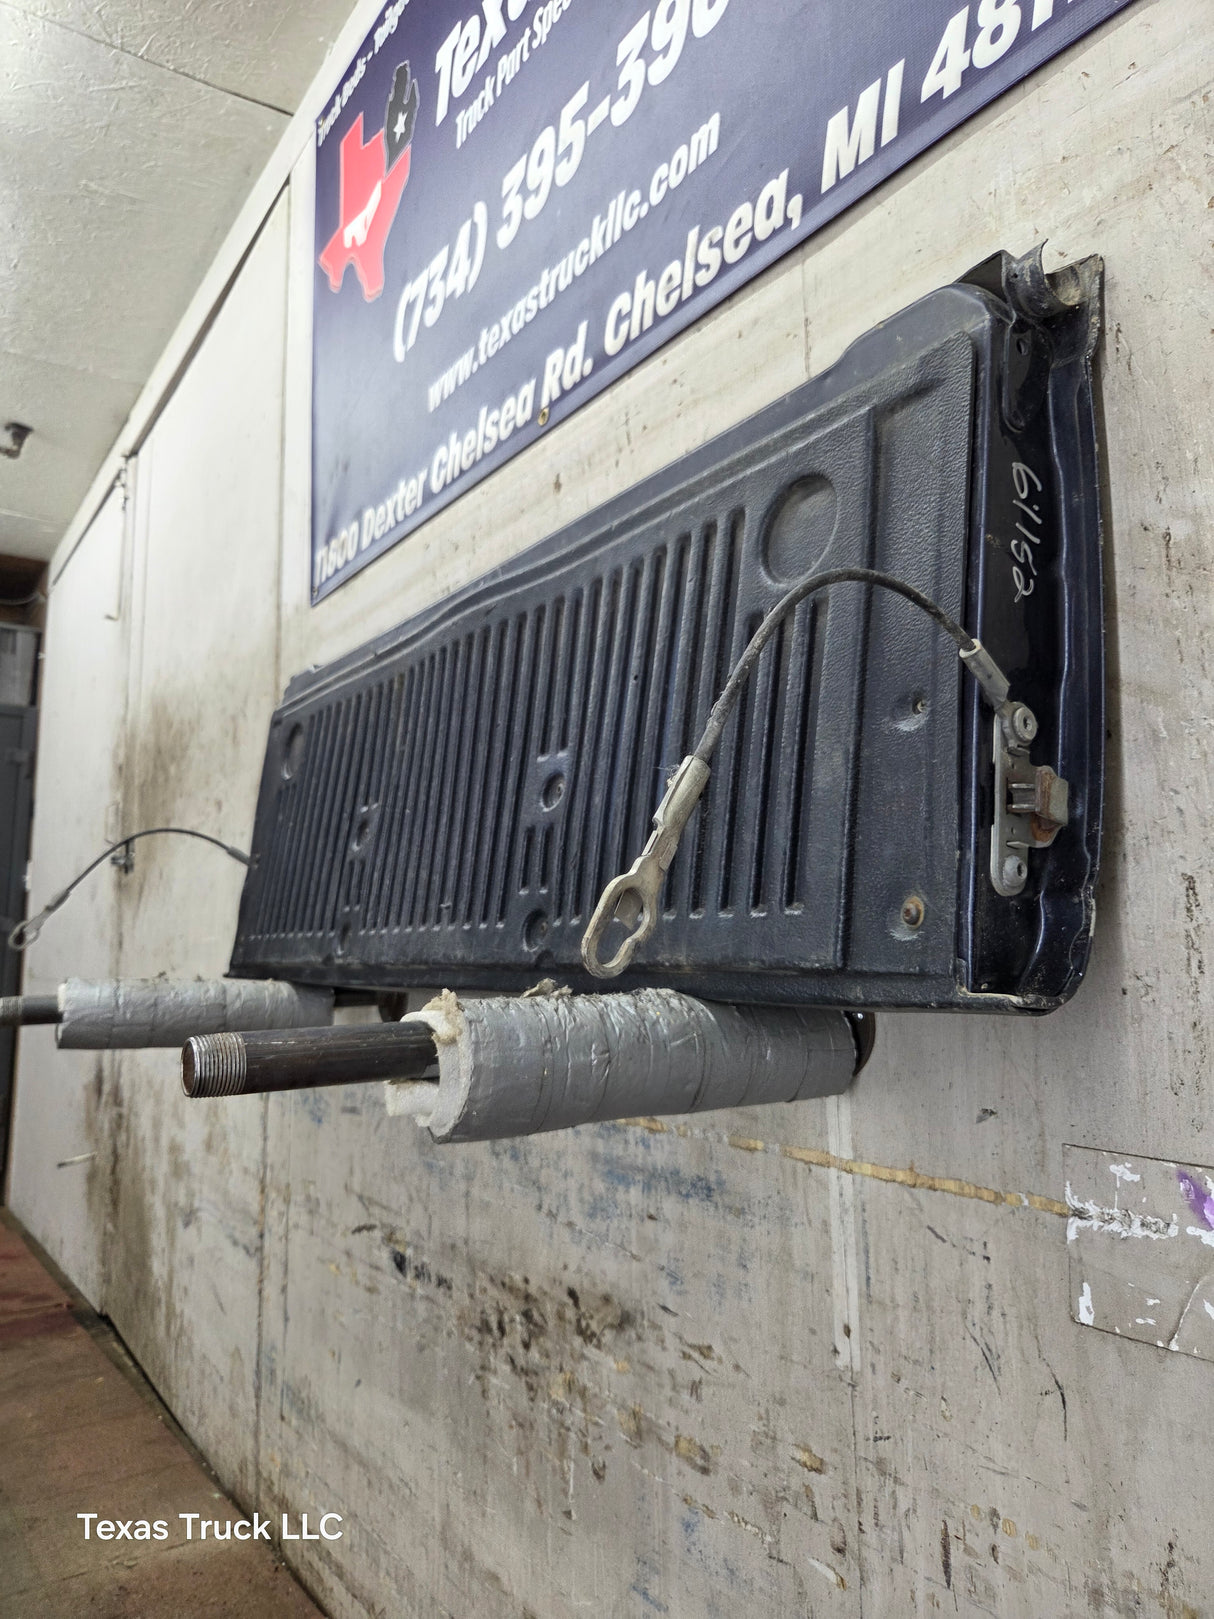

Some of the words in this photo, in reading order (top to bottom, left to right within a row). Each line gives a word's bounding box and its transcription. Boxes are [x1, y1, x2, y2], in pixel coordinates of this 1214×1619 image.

[435, 0, 529, 127] Tex
[456, 109, 495, 149] Truck
[496, 27, 531, 97] Part
[361, 468, 428, 551] Dexter
[430, 378, 537, 494] Chelsea
[540, 319, 594, 409] Rd.
[604, 167, 803, 356] Chelsea,
[821, 58, 905, 194] MI
[393, 201, 488, 363] (734)
[428, 112, 720, 413] www.texastruckllc.com
